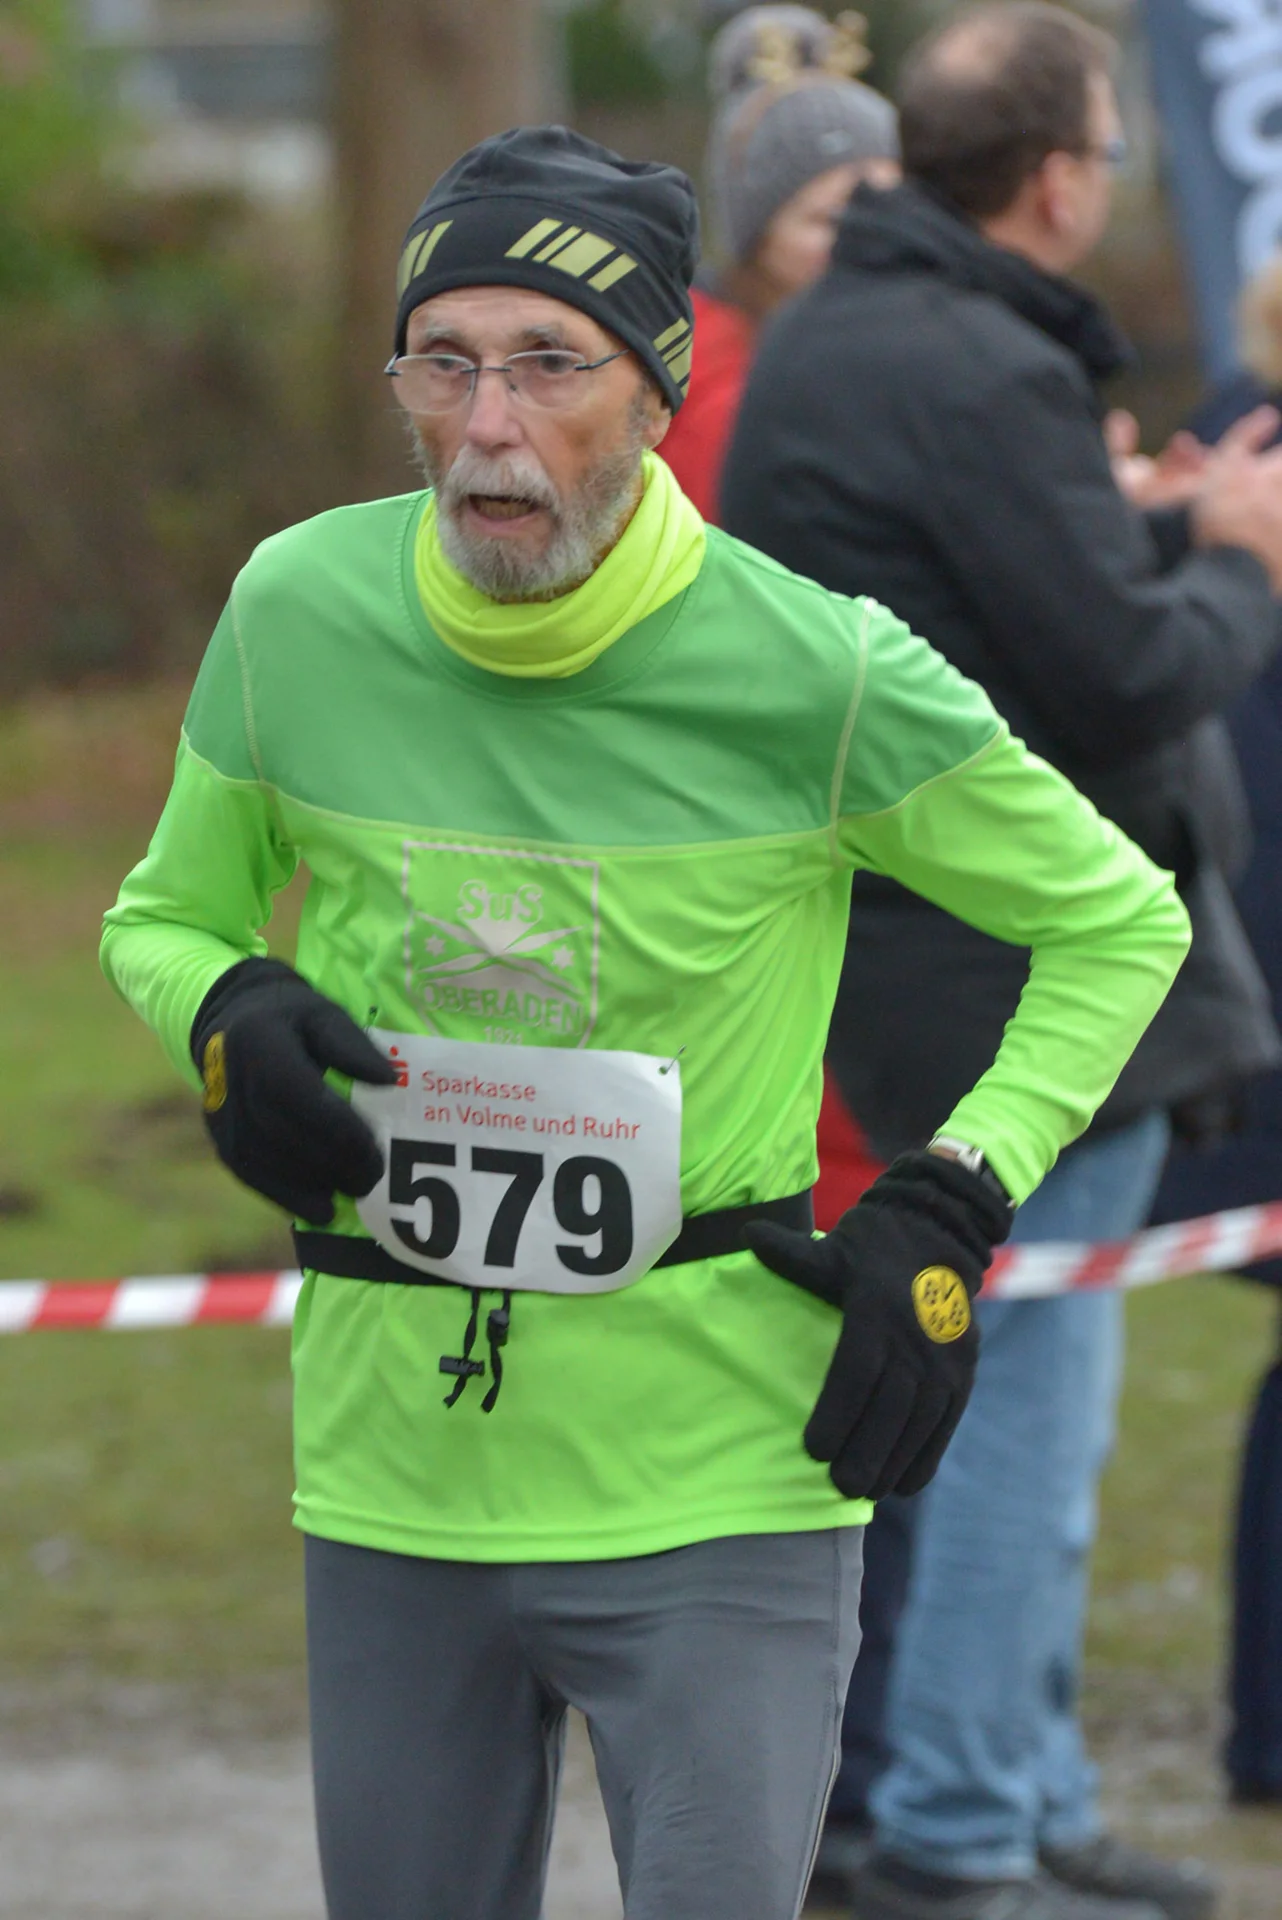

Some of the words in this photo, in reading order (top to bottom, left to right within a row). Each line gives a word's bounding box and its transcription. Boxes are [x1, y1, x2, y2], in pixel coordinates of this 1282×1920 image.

[457, 879, 544, 924] SuS
[418, 982, 585, 1036] OBERADEN
[421, 1070, 537, 1102] Sparkasse
[423, 1104, 450, 1123] an
[456, 1104, 527, 1131] Volme
[533, 1115, 576, 1136] und
[583, 1116, 641, 1140] Ruhr
[388, 1137, 634, 1277] 579
